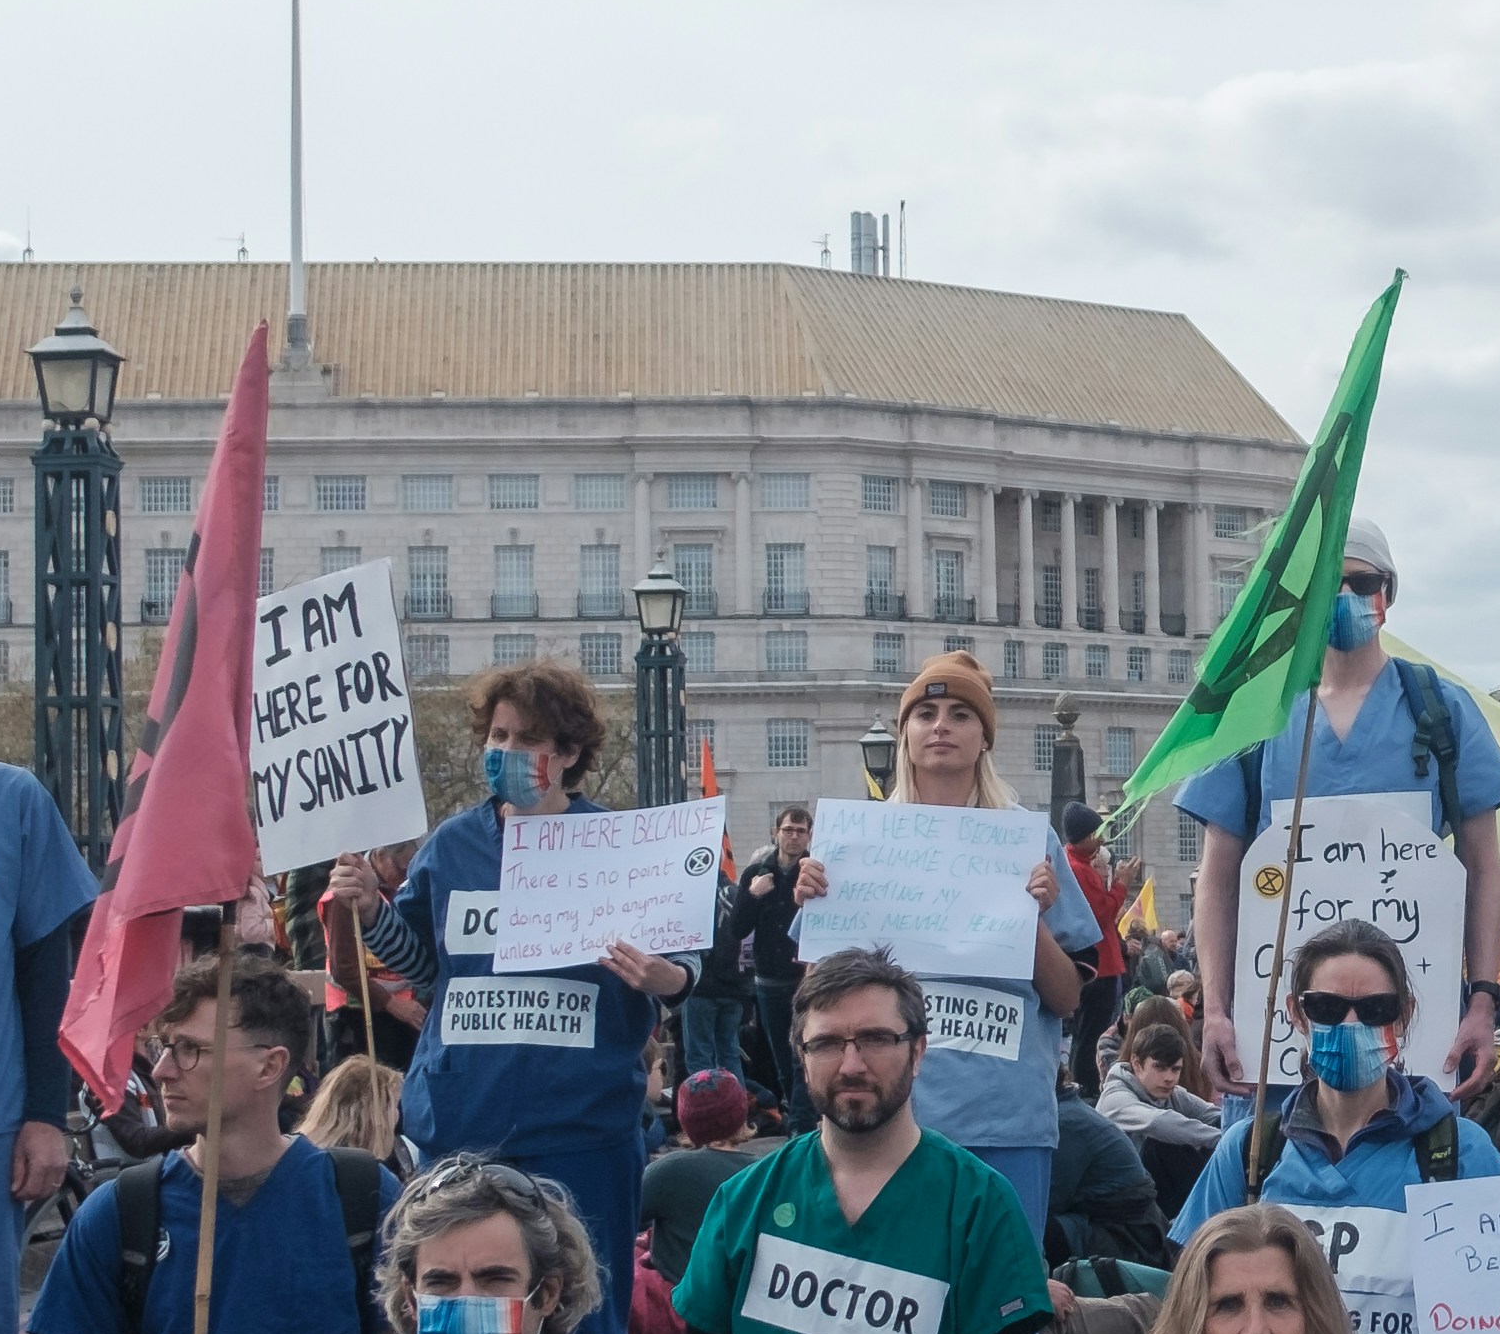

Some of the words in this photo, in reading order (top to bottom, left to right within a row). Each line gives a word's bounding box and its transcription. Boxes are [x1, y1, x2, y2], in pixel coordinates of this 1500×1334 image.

[260, 604, 292, 667] I
[301, 582, 362, 652] AM
[254, 674, 327, 743] HERE
[335, 651, 404, 712] FOR
[252, 757, 292, 827] MY
[296, 714, 408, 812] SANITY
[571, 815, 624, 848] HERE
[632, 805, 719, 845] BECAUSE
[1324, 842, 1366, 863] am
[1380, 827, 1437, 861] here
[950, 854, 1022, 877] CRISIS
[621, 891, 685, 919] anymore
[1292, 889, 1353, 931] for
[447, 990, 550, 1010] PROTESTING
[556, 992, 591, 1012] FOR
[985, 1002, 1019, 1025] FOR
[451, 1013, 507, 1030] PUBLIC
[513, 1013, 581, 1034] HEALTH
[941, 1018, 1008, 1045] HEALTH
[1423, 1203, 1455, 1241] I
[1371, 1312, 1413, 1334] FOR
